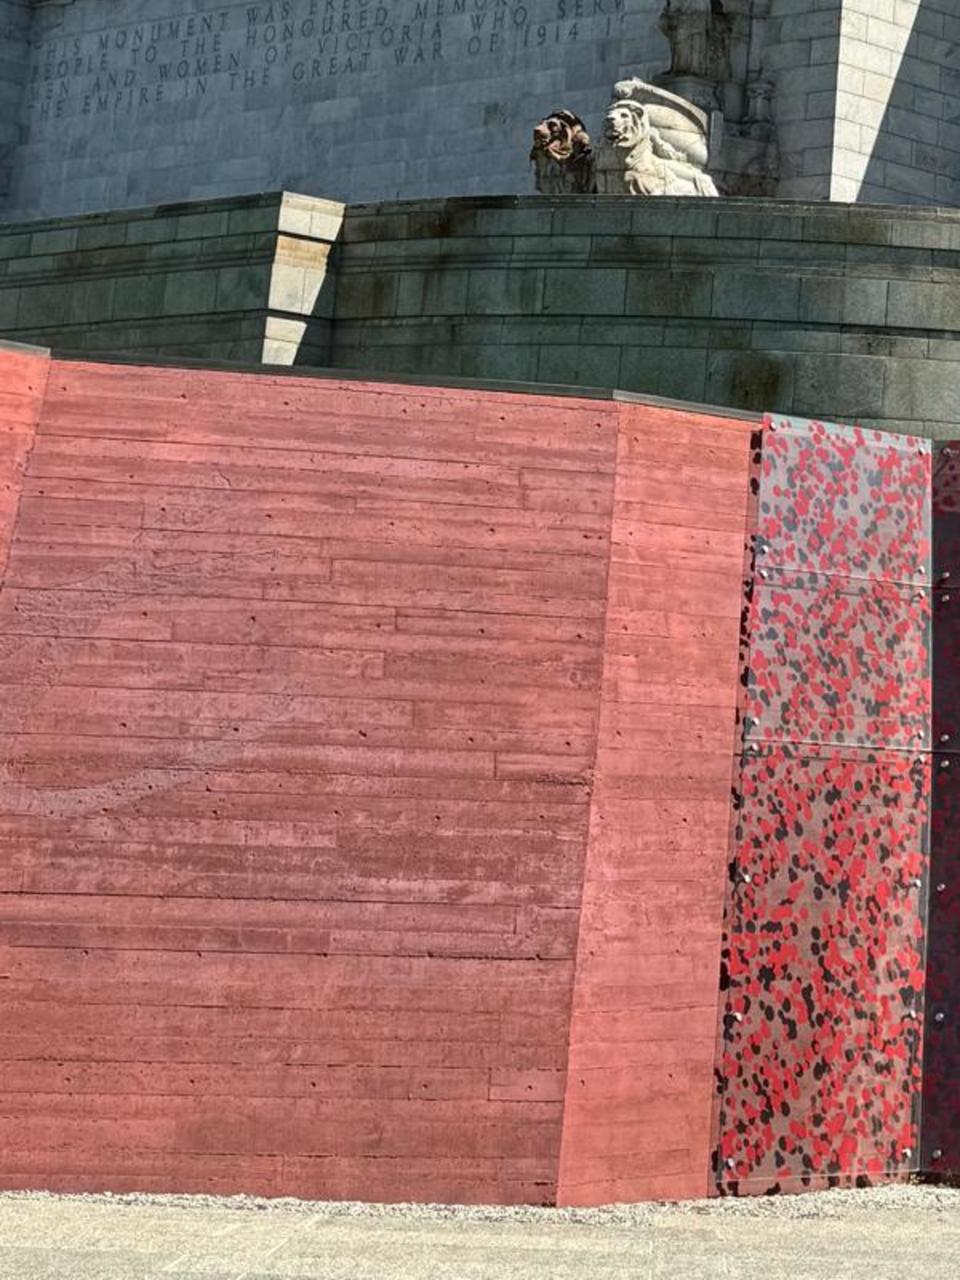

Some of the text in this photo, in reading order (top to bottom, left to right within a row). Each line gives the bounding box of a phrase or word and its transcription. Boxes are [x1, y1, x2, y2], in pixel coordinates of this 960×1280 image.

[91, 68, 136, 96] AND
[159, 51, 240, 79] WOMEN
[265, 43, 292, 65] OF
[318, 21, 443, 56] VICTORIA
[470, 5, 528, 32] WHO
[99, 11, 229, 50] MONUMENT
[246, 1, 291, 25] WAS
[132, 45, 157, 65] TO
[181, 33, 220, 58] THE
[246, 6, 388, 48] HONOURED
[82, 83, 164, 116] EMPIRE
[184, 76, 208, 98] IN
[228, 66, 270, 91] THE
[292, 52, 371, 82] GREAT
[393, 41, 443, 65] WAR
[467, 33, 499, 55] OF
[523, 22, 579, 48] 1914
